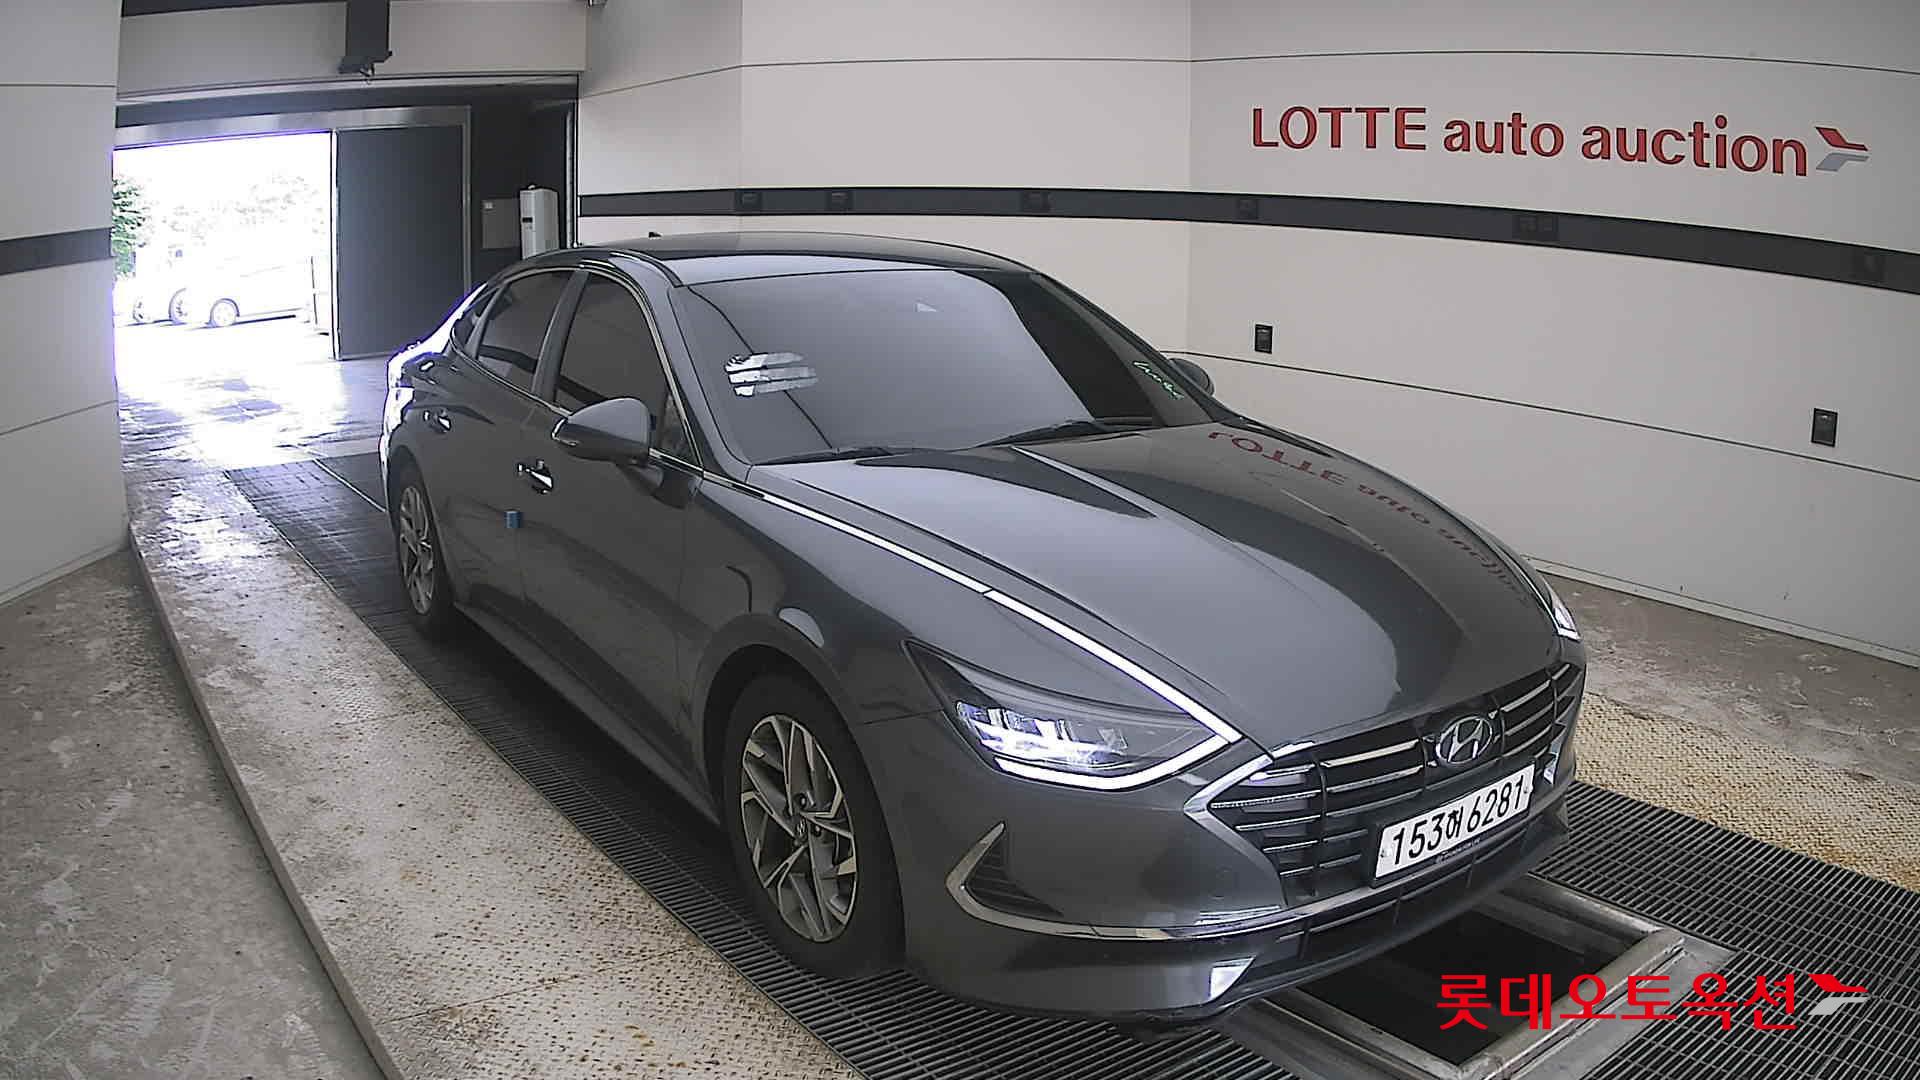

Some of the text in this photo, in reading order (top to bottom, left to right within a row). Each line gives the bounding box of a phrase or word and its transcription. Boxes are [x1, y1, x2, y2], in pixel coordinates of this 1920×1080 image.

[1253, 107, 1809, 177] LOTTE auto auction
